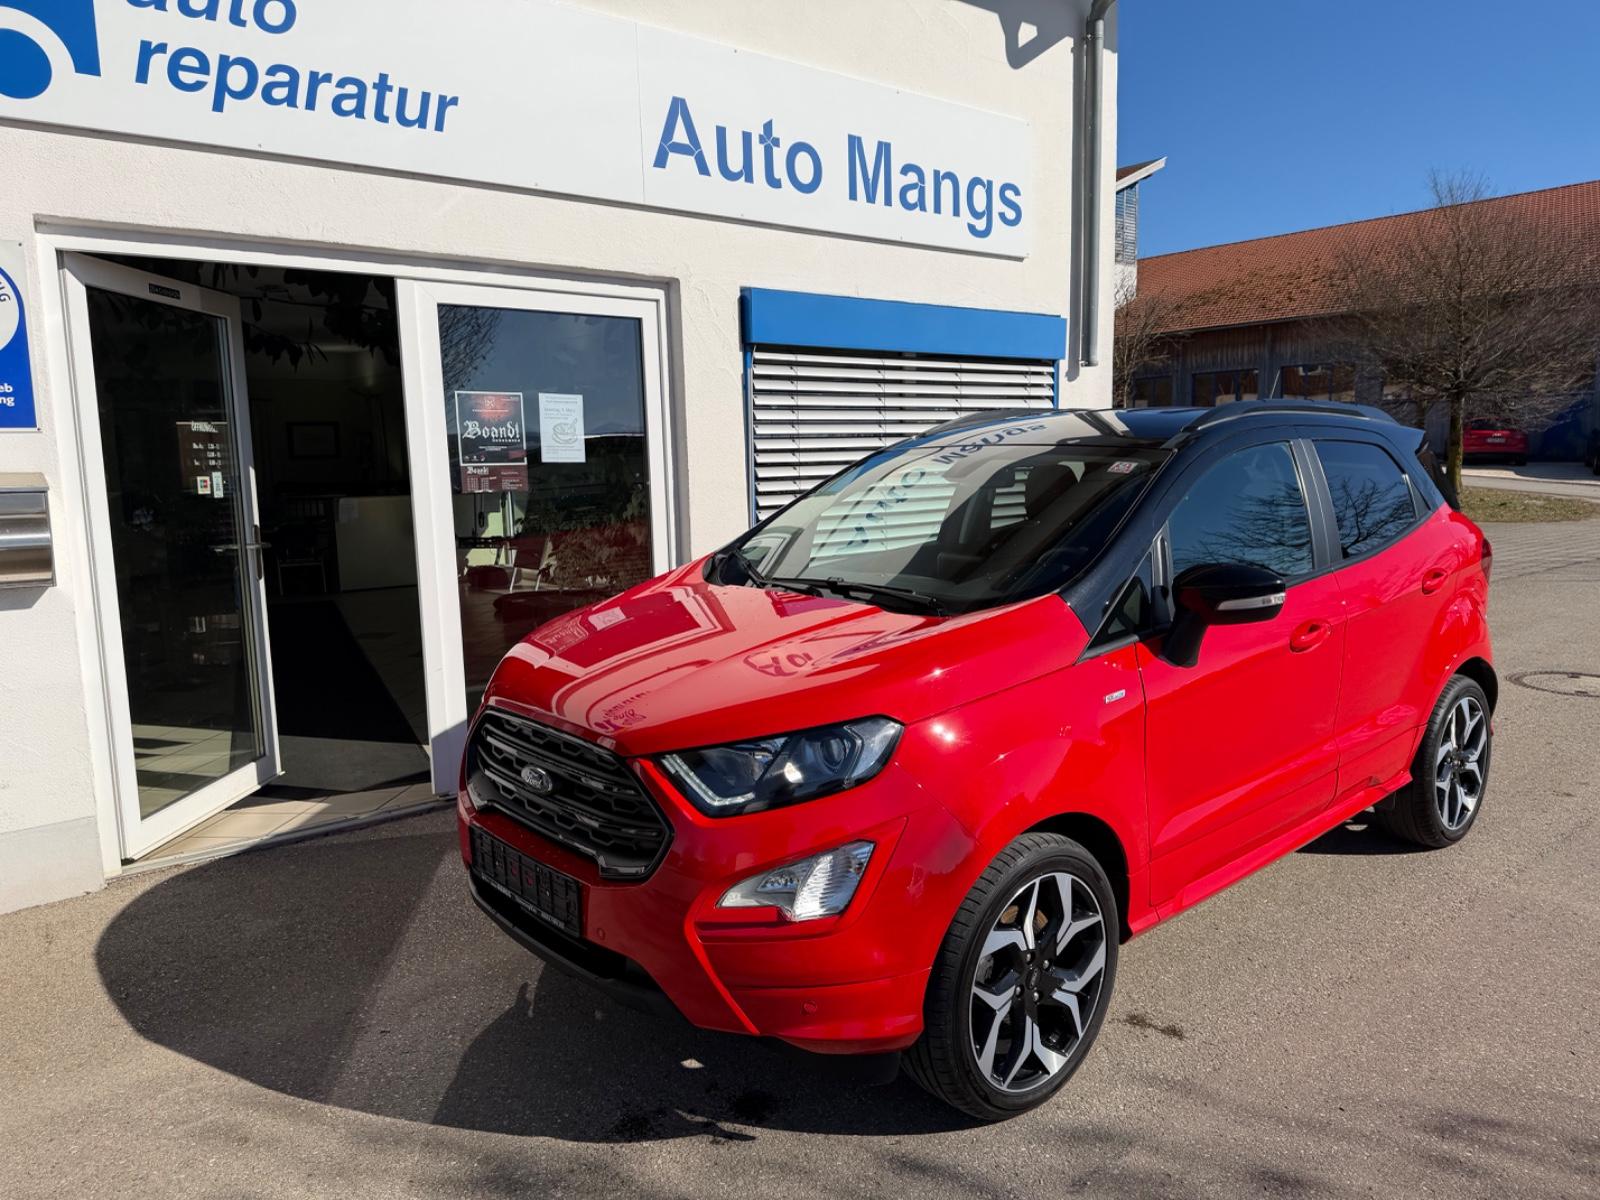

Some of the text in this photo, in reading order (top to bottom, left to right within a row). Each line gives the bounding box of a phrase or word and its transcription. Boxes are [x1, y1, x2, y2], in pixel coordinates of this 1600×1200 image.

[128, 0, 296, 33] to
[135, 39, 459, 133] reparatur
[654, 96, 1023, 238] Auto Mangs
